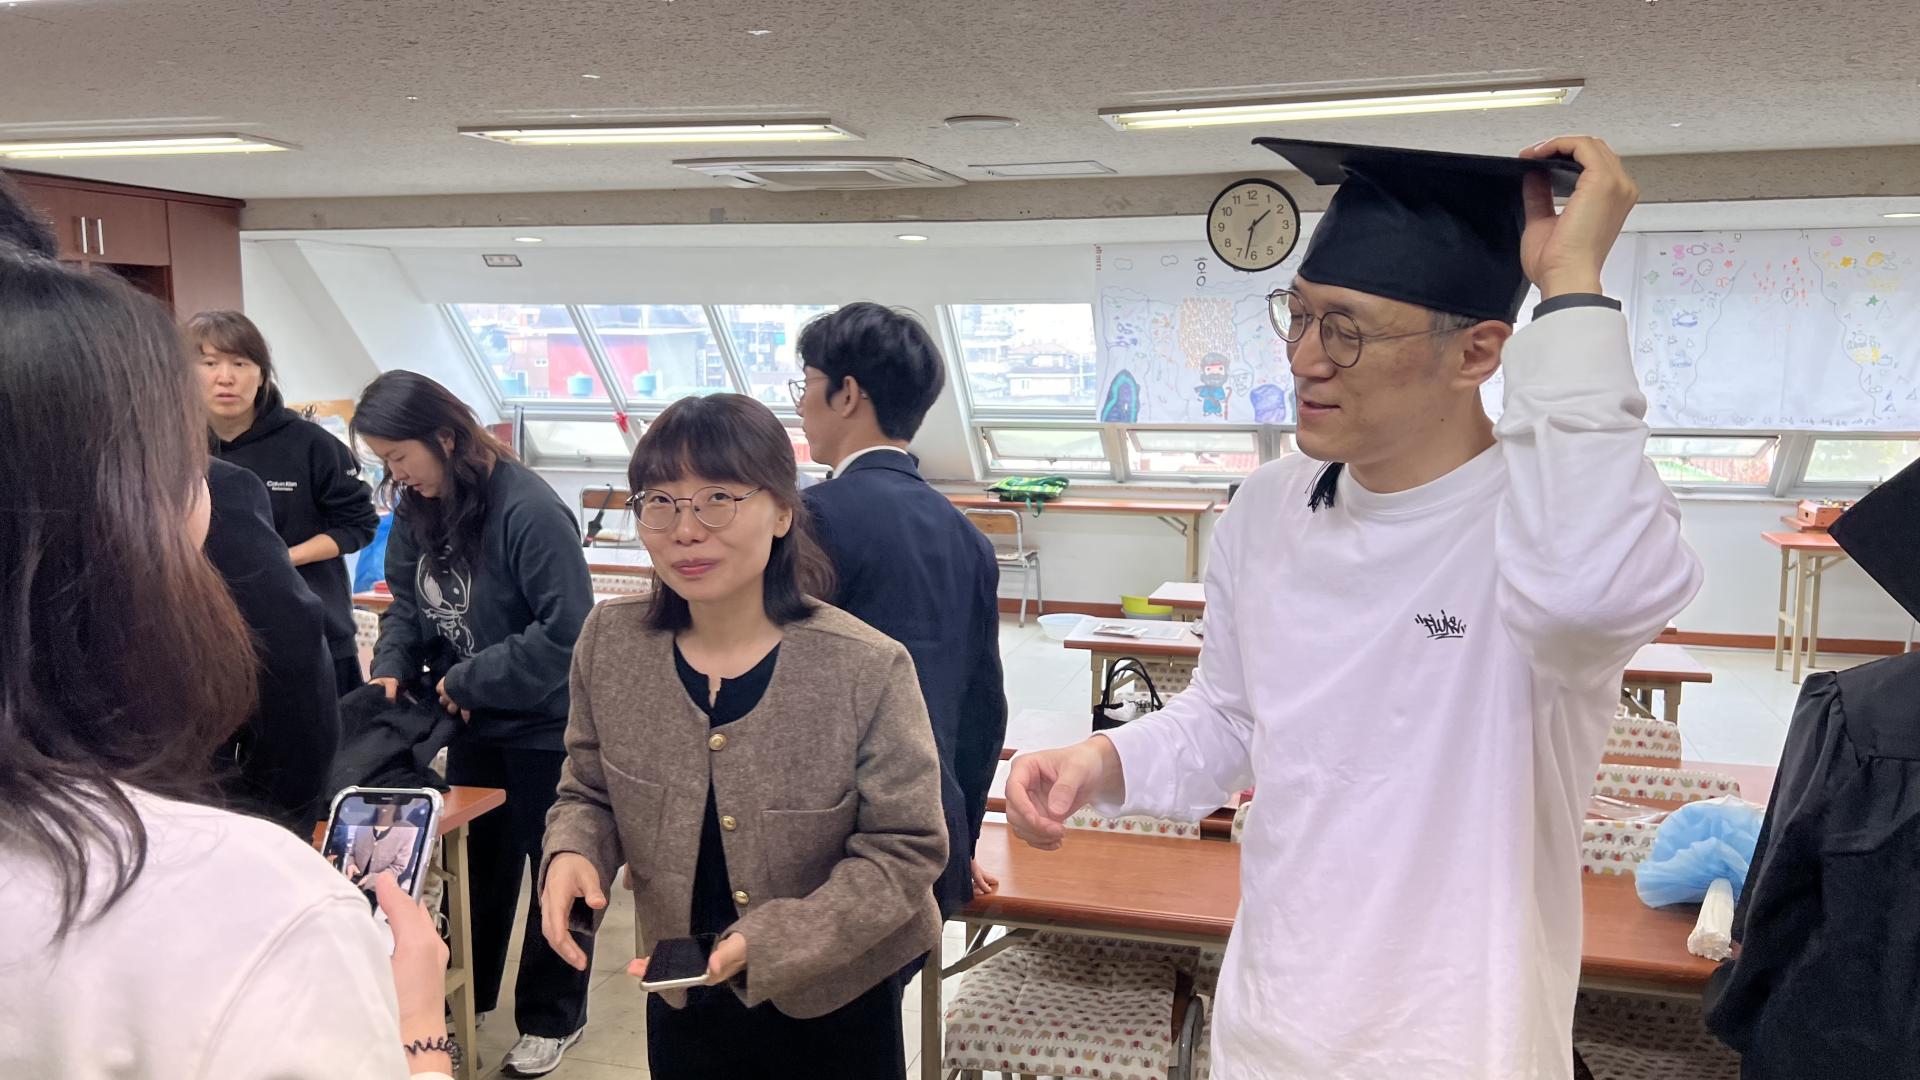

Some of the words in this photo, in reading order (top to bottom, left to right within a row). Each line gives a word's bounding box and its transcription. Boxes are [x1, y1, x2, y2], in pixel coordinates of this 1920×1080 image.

[1232, 195, 1241, 204] 11
[1246, 189, 1258, 200] 12
[1266, 194, 1271, 203] 1
[1221, 206, 1233, 217] 10
[1276, 204, 1284, 214] 2
[1217, 222, 1225, 232] 9
[1282, 219, 1290, 230] 3
[1224, 238, 1232, 248] 8
[1276, 236, 1284, 245] 4
[1236, 247, 1243, 257] 7
[1250, 250, 1258, 260] 6
[1266, 246, 1274, 256] 5
